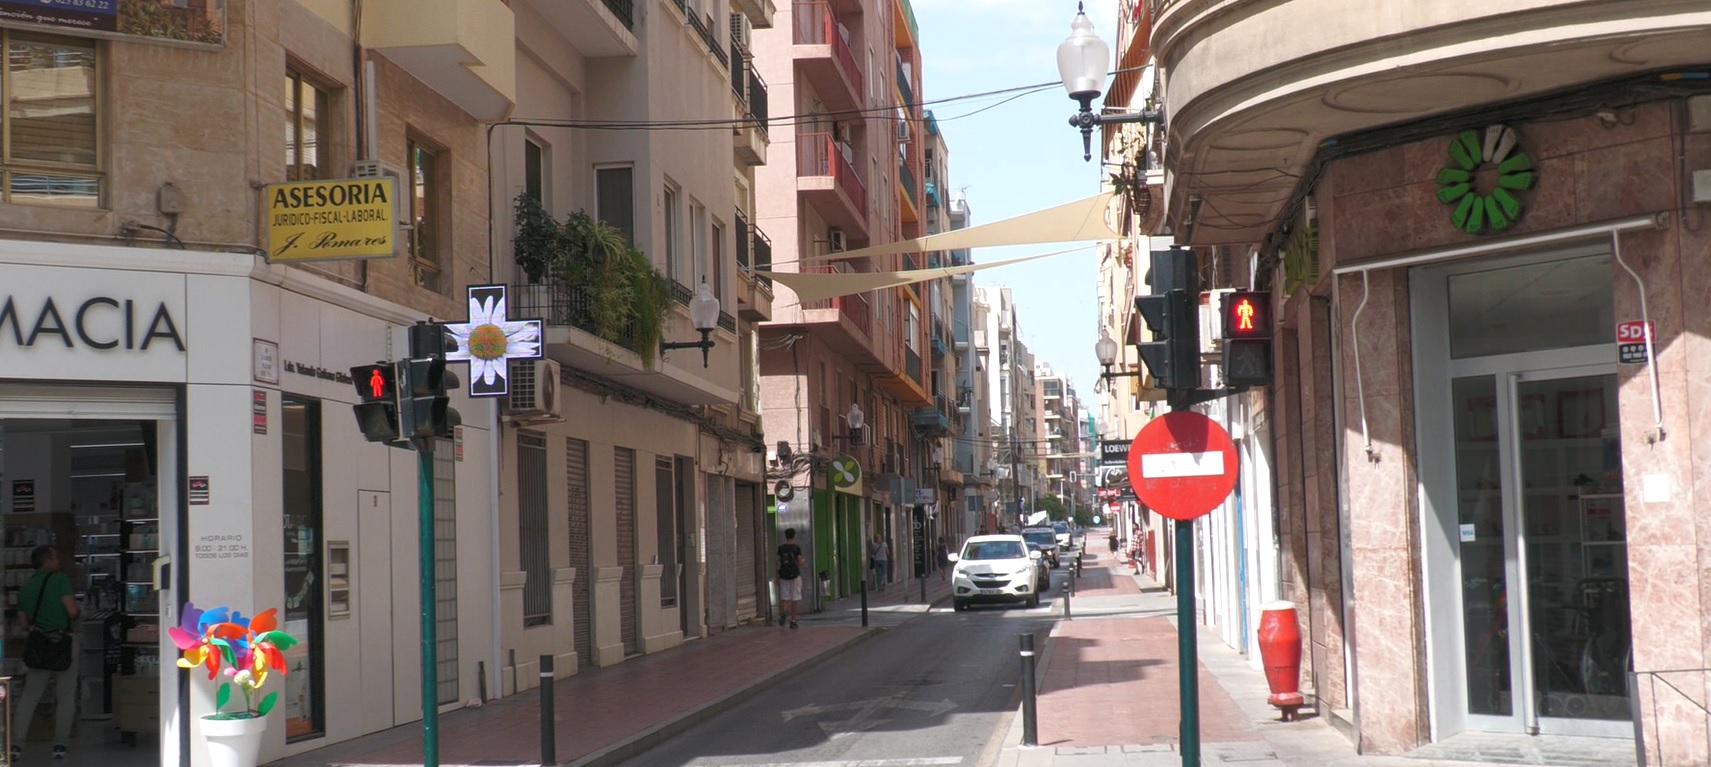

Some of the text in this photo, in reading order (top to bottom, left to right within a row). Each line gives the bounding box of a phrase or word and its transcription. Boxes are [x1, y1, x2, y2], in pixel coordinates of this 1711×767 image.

[85, 0, 97, 8] 62
[98, 1, 109, 9] 22
[36, 15, 57, 24] que
[273, 183, 387, 209] ASESORIA
[272, 231, 386, 257] J. Pomares
